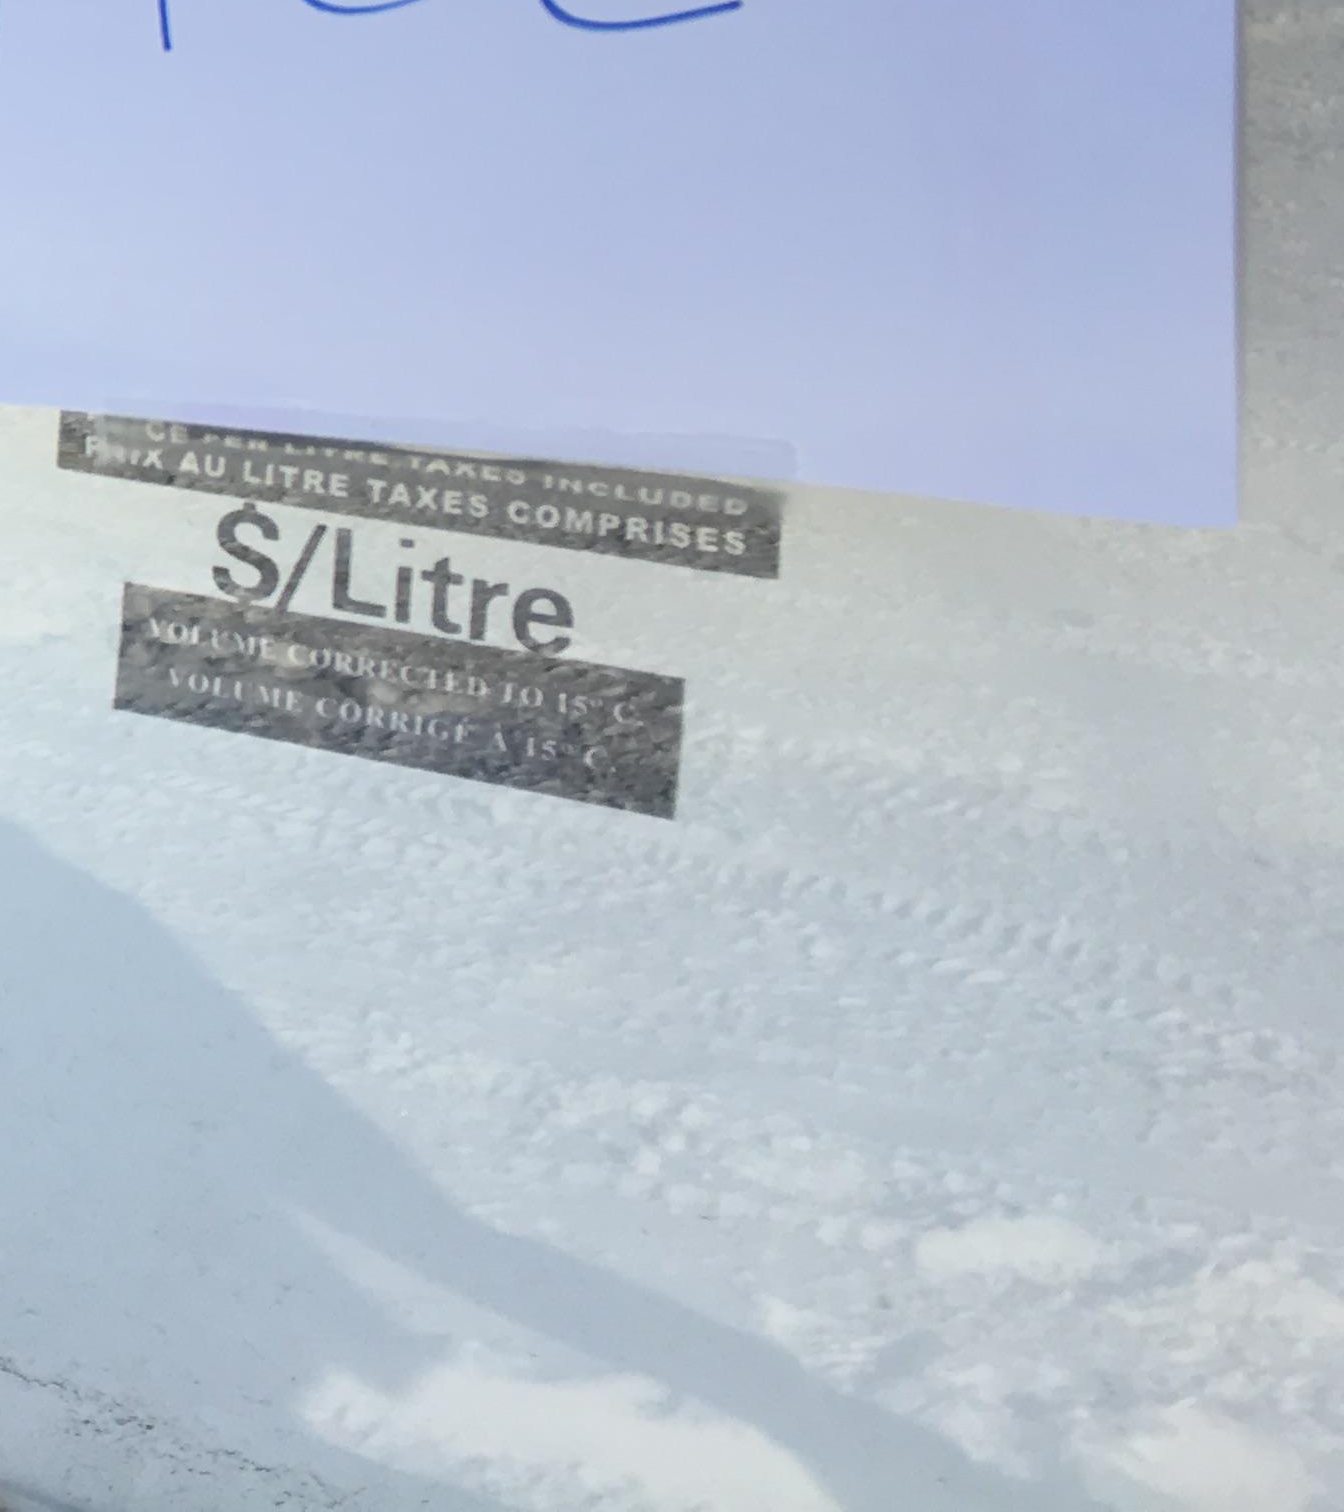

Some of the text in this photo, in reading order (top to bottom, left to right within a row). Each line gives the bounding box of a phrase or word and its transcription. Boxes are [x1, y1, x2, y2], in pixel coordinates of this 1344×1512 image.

[179, 450, 226, 478] AU
[242, 459, 350, 498] LITRE
[366, 477, 490, 518] TAXES
[506, 499, 747, 556] COMPRISES
[543, 474, 749, 516] INCLUDED
[148, 617, 276, 657] VOLUME
[287, 643, 491, 698] CORRECTED
[500, 681, 544, 708] TO
[168, 666, 304, 714] VOLUME
